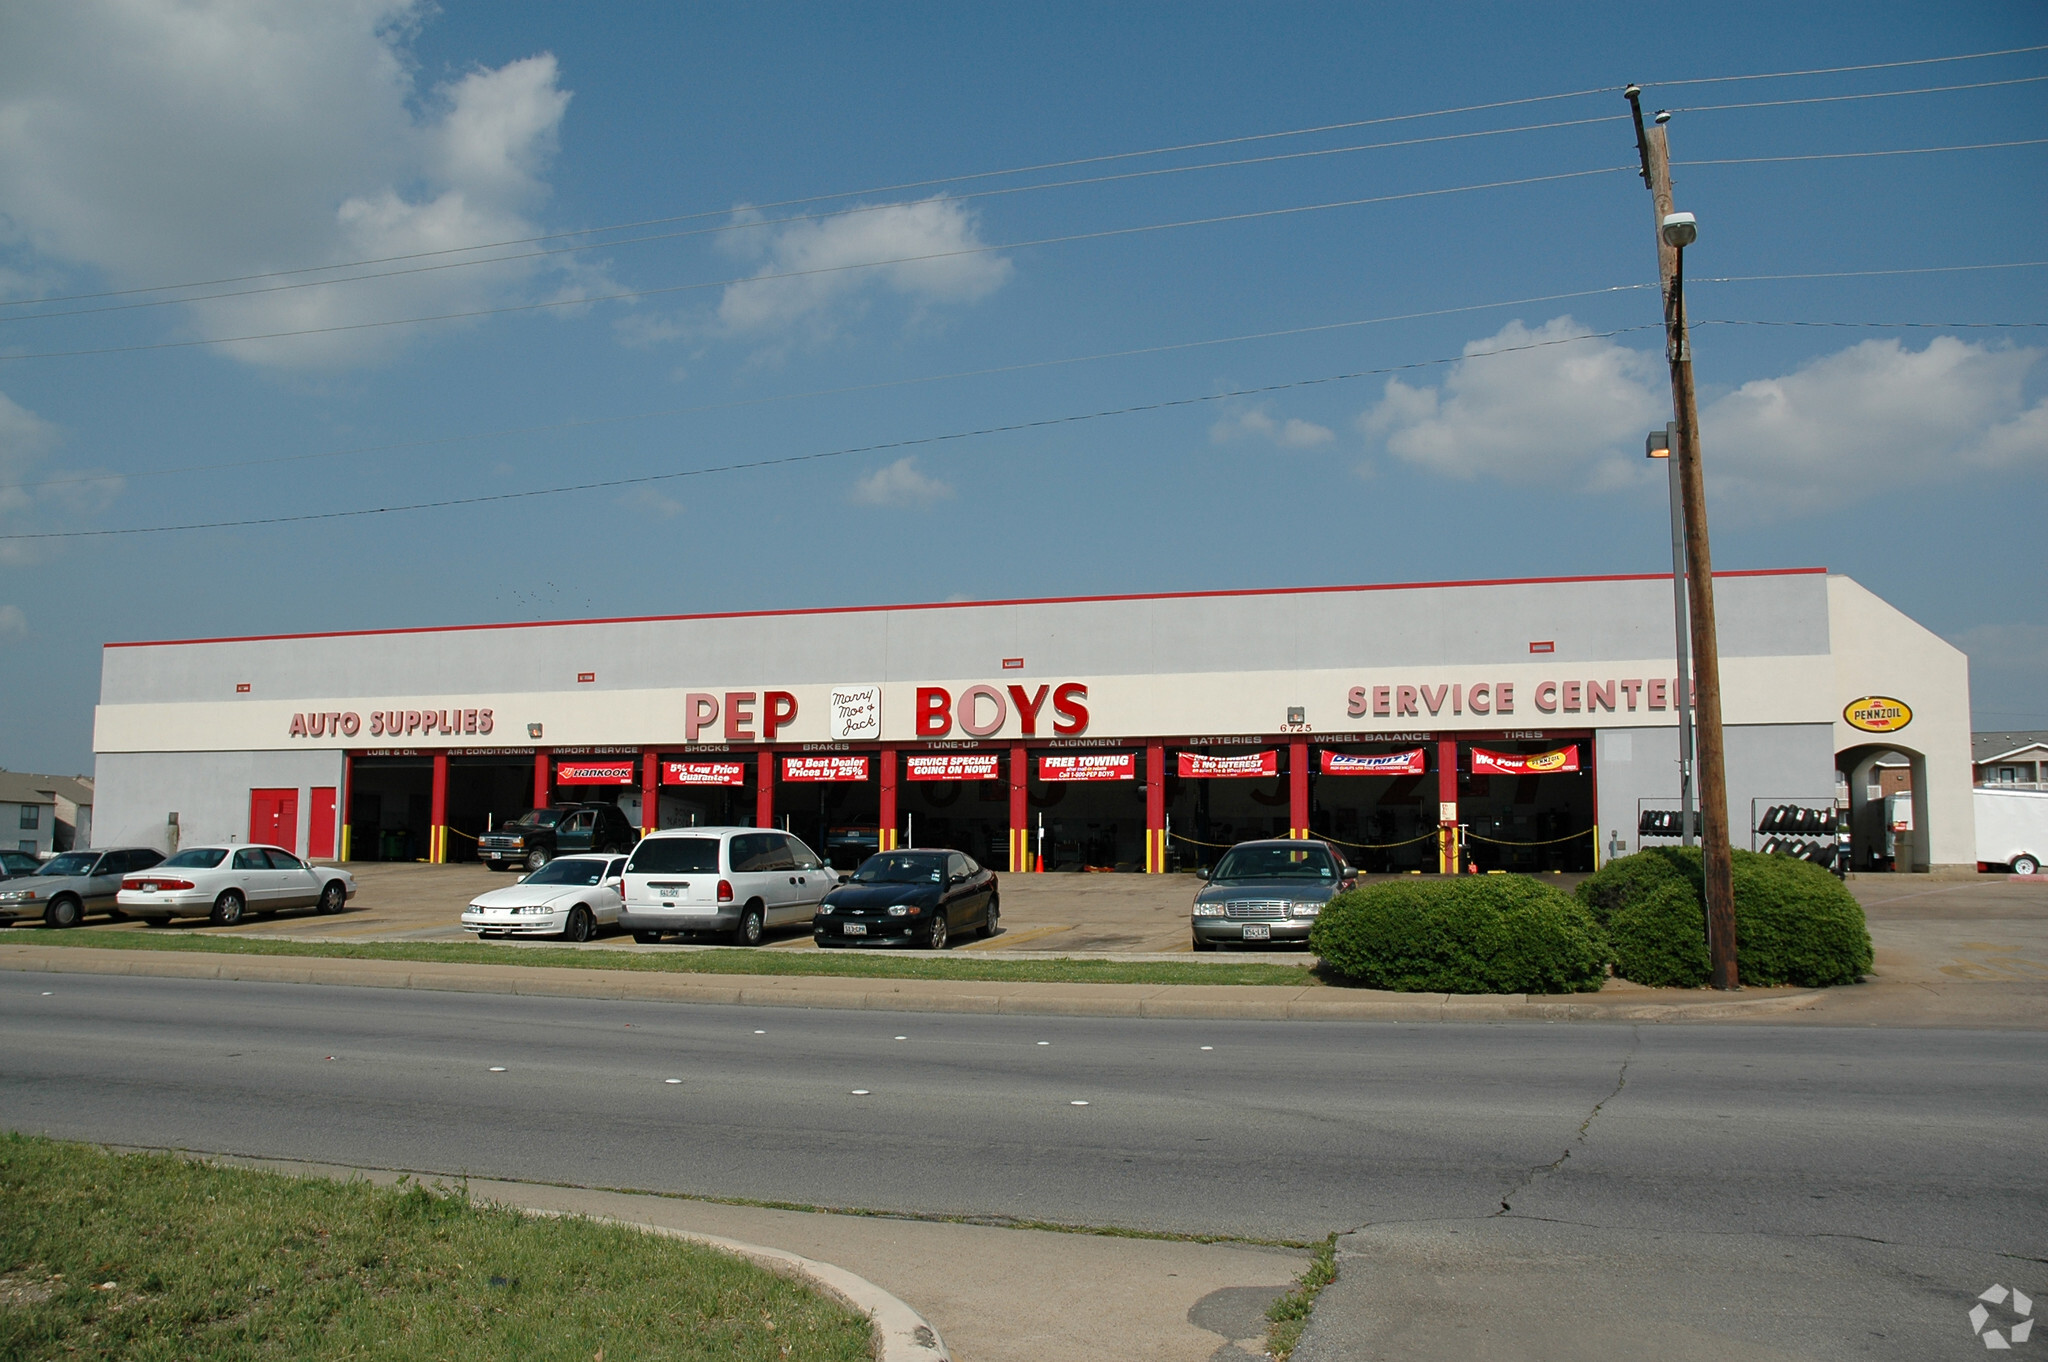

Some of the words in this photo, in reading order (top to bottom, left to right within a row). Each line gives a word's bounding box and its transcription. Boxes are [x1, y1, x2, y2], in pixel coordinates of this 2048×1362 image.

[832, 689, 874, 706] Manny
[1347, 682, 1514, 716] SERVICE
[685, 690, 799, 740] PEP
[916, 682, 1090, 736] BOYS
[838, 705, 864, 719] Moe
[1854, 707, 1902, 720] PENNZOIL
[288, 711, 361, 737] AUTO
[368, 708, 494, 736] SUPPLIES
[842, 713, 877, 737] Jack
[1280, 723, 1312, 733] 6725
[1314, 734, 1360, 742] WHEEL
[1365, 732, 1431, 742] BALANCE
[1503, 730, 1544, 739] TIRES
[927, 741, 979, 749] TUNE-UP
[1049, 738, 1124, 747] ALIGNMENT
[1189, 736, 1262, 745] BATTERIES
[466, 747, 536, 756] CONDITIONING
[552, 746, 591, 754] IMPORT
[594, 746, 638, 754] SERVICE
[684, 744, 730, 752] SHOCKS
[803, 743, 850, 751] BRAKES
[787, 758, 803, 768] We
[805, 758, 830, 768] Beat
[831, 757, 866, 767] Dealer
[908, 757, 949, 767] SERVICE
[950, 756, 998, 765] SPECIALS
[1045, 757, 1076, 768] FREE
[1078, 755, 1129, 767] TOWING
[1202, 760, 1217, 769] NO
[1217, 759, 1264, 768] INTEREST
[1475, 754, 1494, 765] We
[1496, 758, 1525, 767] Pour
[670, 763, 687, 773] 5%
[689, 764, 711, 774] Low
[713, 764, 740, 774] Price
[788, 768, 821, 777] Prices
[823, 767, 837, 778] by
[838, 766, 863, 776] 25%
[914, 766, 946, 775] GOING
[947, 765, 963, 774] ON
[964, 764, 992, 774] NOW!
[679, 772, 730, 782] Guarantee
